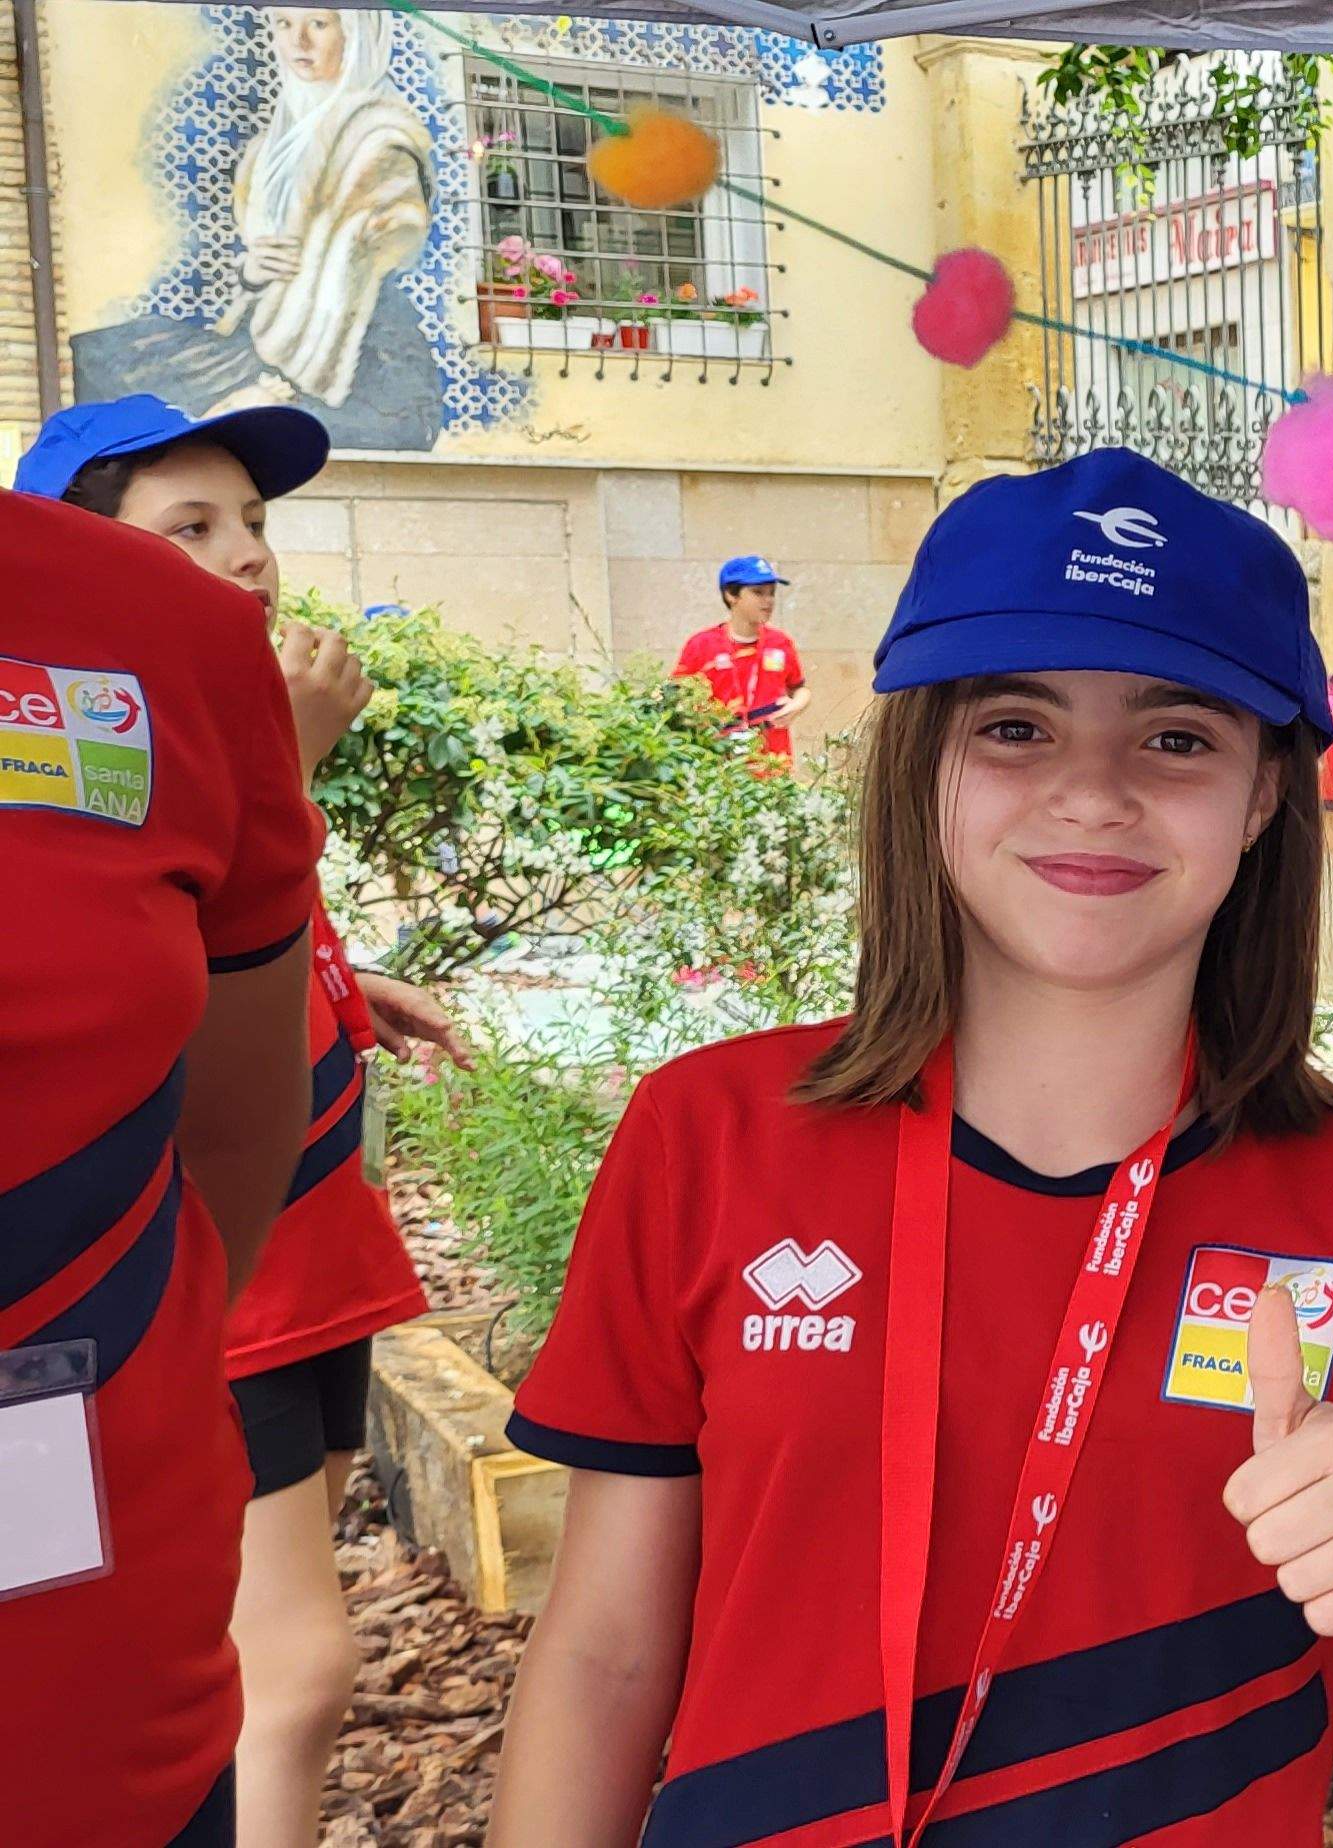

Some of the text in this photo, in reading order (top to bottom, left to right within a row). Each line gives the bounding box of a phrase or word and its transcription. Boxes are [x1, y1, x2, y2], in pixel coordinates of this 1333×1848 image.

[1071, 549, 1156, 578] Fundación
[1, 757, 69, 778] FRAGA
[84, 763, 145, 791] santa
[88, 789, 142, 821] ANA
[742, 1314, 857, 1352] errea
[1182, 1353, 1243, 1375] FRAGA
